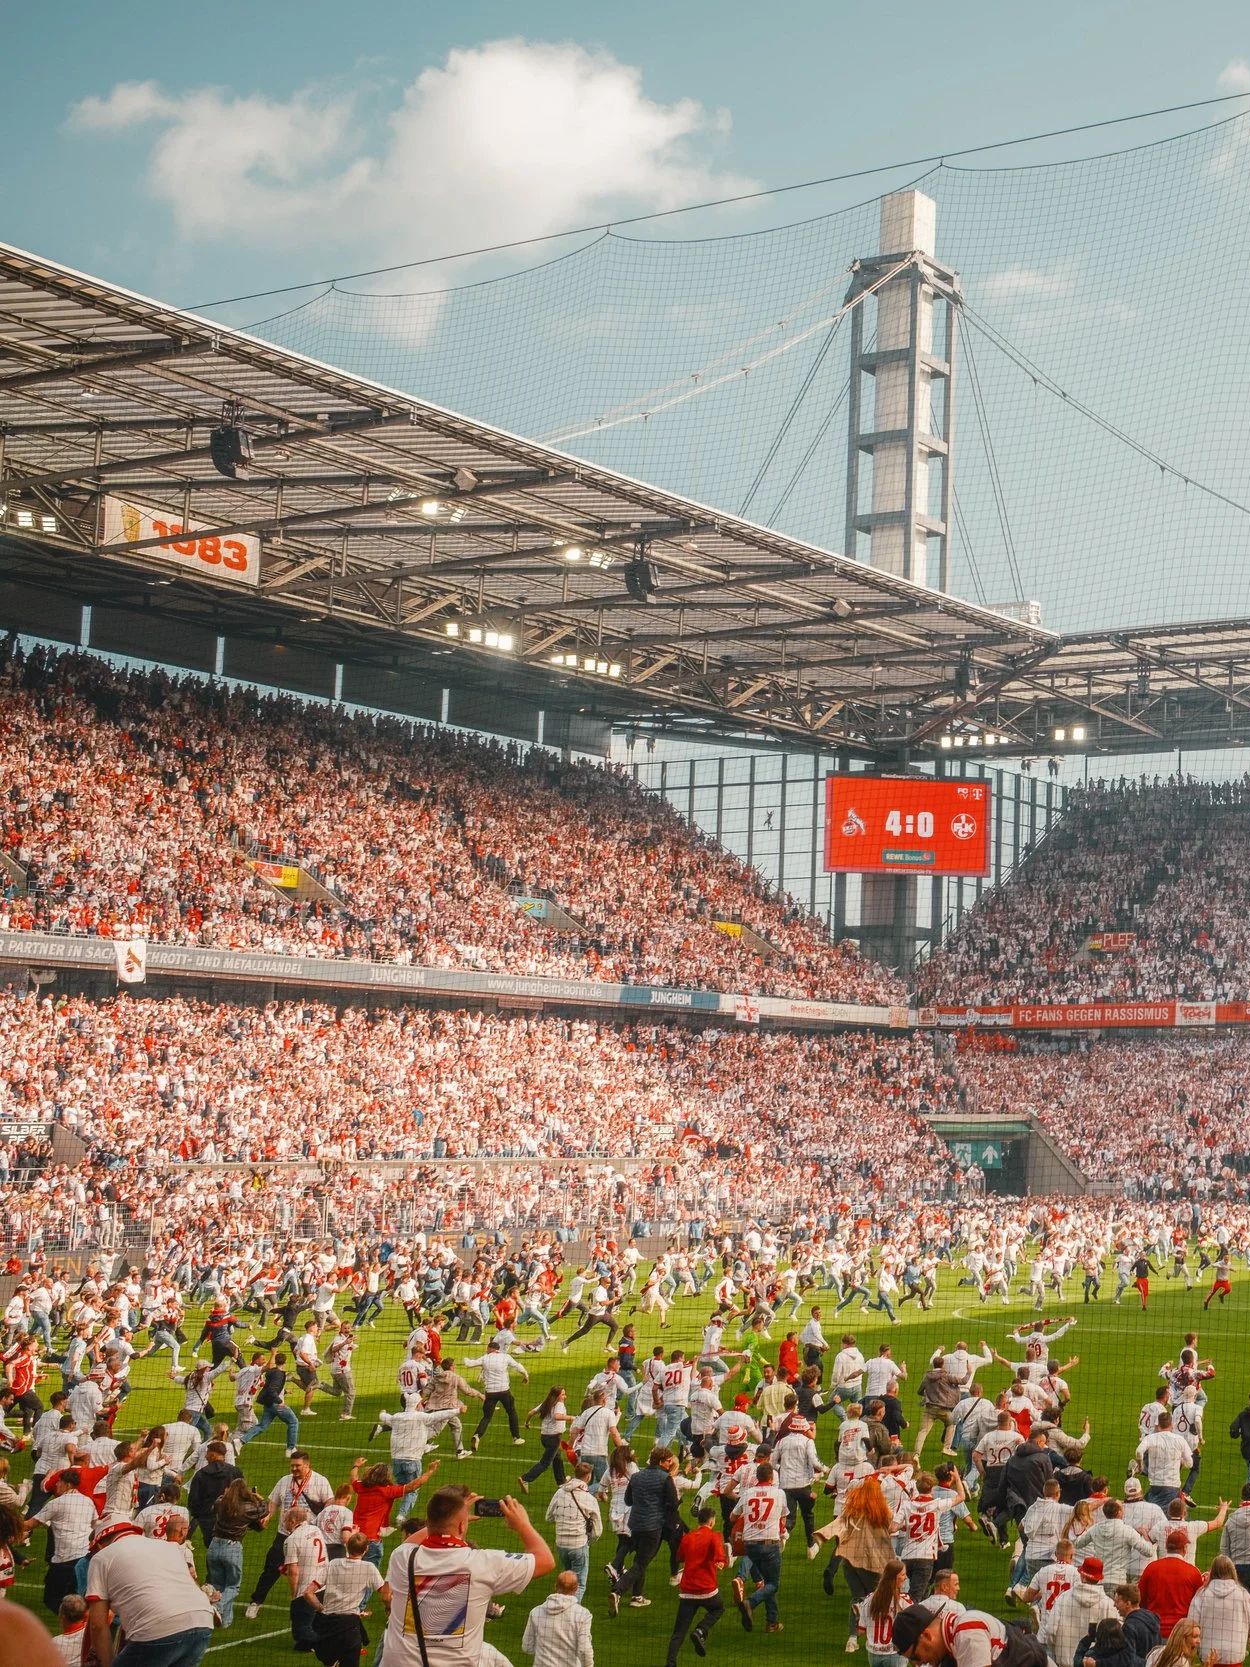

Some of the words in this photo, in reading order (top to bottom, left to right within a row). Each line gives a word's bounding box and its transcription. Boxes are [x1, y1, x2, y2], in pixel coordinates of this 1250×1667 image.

[885, 810, 934, 838] 4:0
[8, 940, 65, 957] PARTNER
[68, 944, 82, 957] IN
[196, 955, 221, 968] UND
[222, 957, 303, 975] METALLHANDEL
[369, 968, 425, 985] JUNGHEIM
[487, 978, 602, 998] www.jungheim-bonn.de
[650, 990, 692, 1006] JUNGHEIM
[1019, 1009, 1063, 1022] FC-FANS
[1066, 1008, 1101, 1021] GEGEN
[1104, 1007, 1169, 1020] RASSISMUS
[401, 1370, 414, 1387] 10
[664, 1369, 682, 1387] 20
[748, 1498, 775, 1523] 37
[909, 1511, 936, 1539] 24
[873, 1615, 893, 1645] 10
